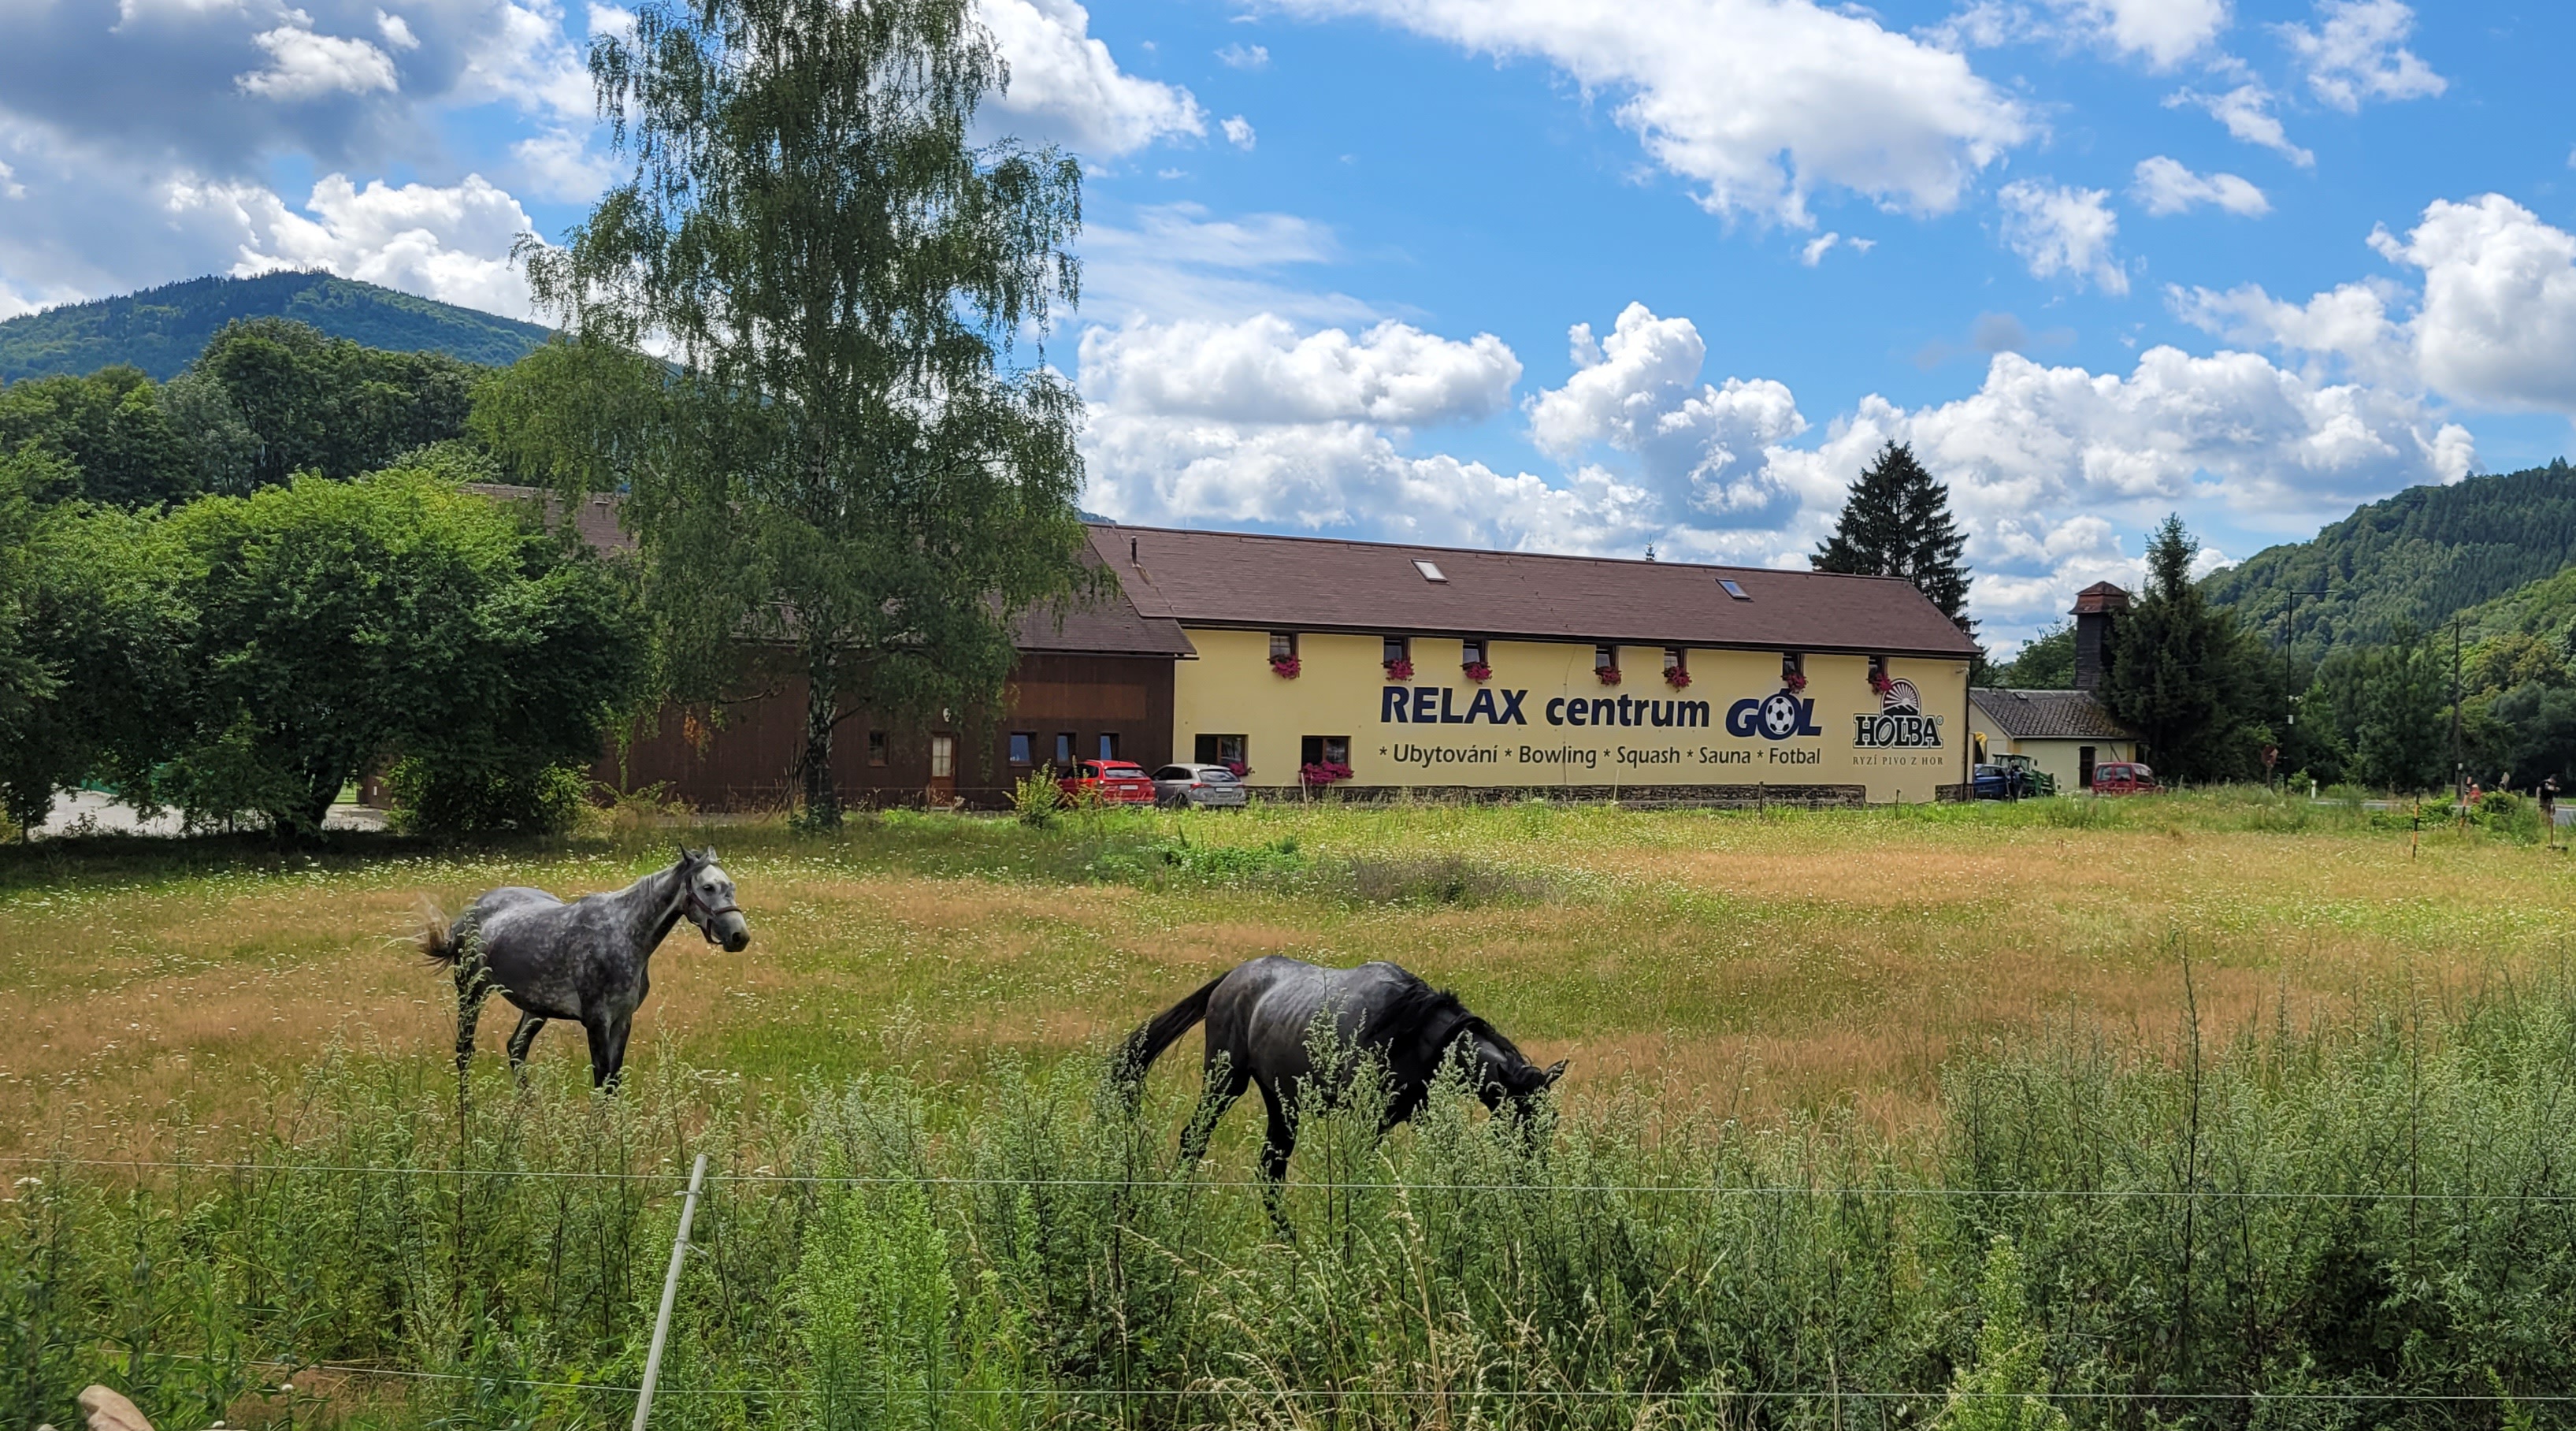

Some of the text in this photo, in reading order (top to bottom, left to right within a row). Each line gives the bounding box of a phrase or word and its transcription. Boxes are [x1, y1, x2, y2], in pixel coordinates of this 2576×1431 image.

[1380, 686, 1528, 725] RELAX
[1546, 693, 1709, 727] centrum
[1853, 714, 1943, 749] HOLBA
[1393, 744, 1821, 768] Ubytování Bowling Squash Sauna Fotbal
[1853, 754, 1943, 765] RYZÍ PIVO Z HOR
